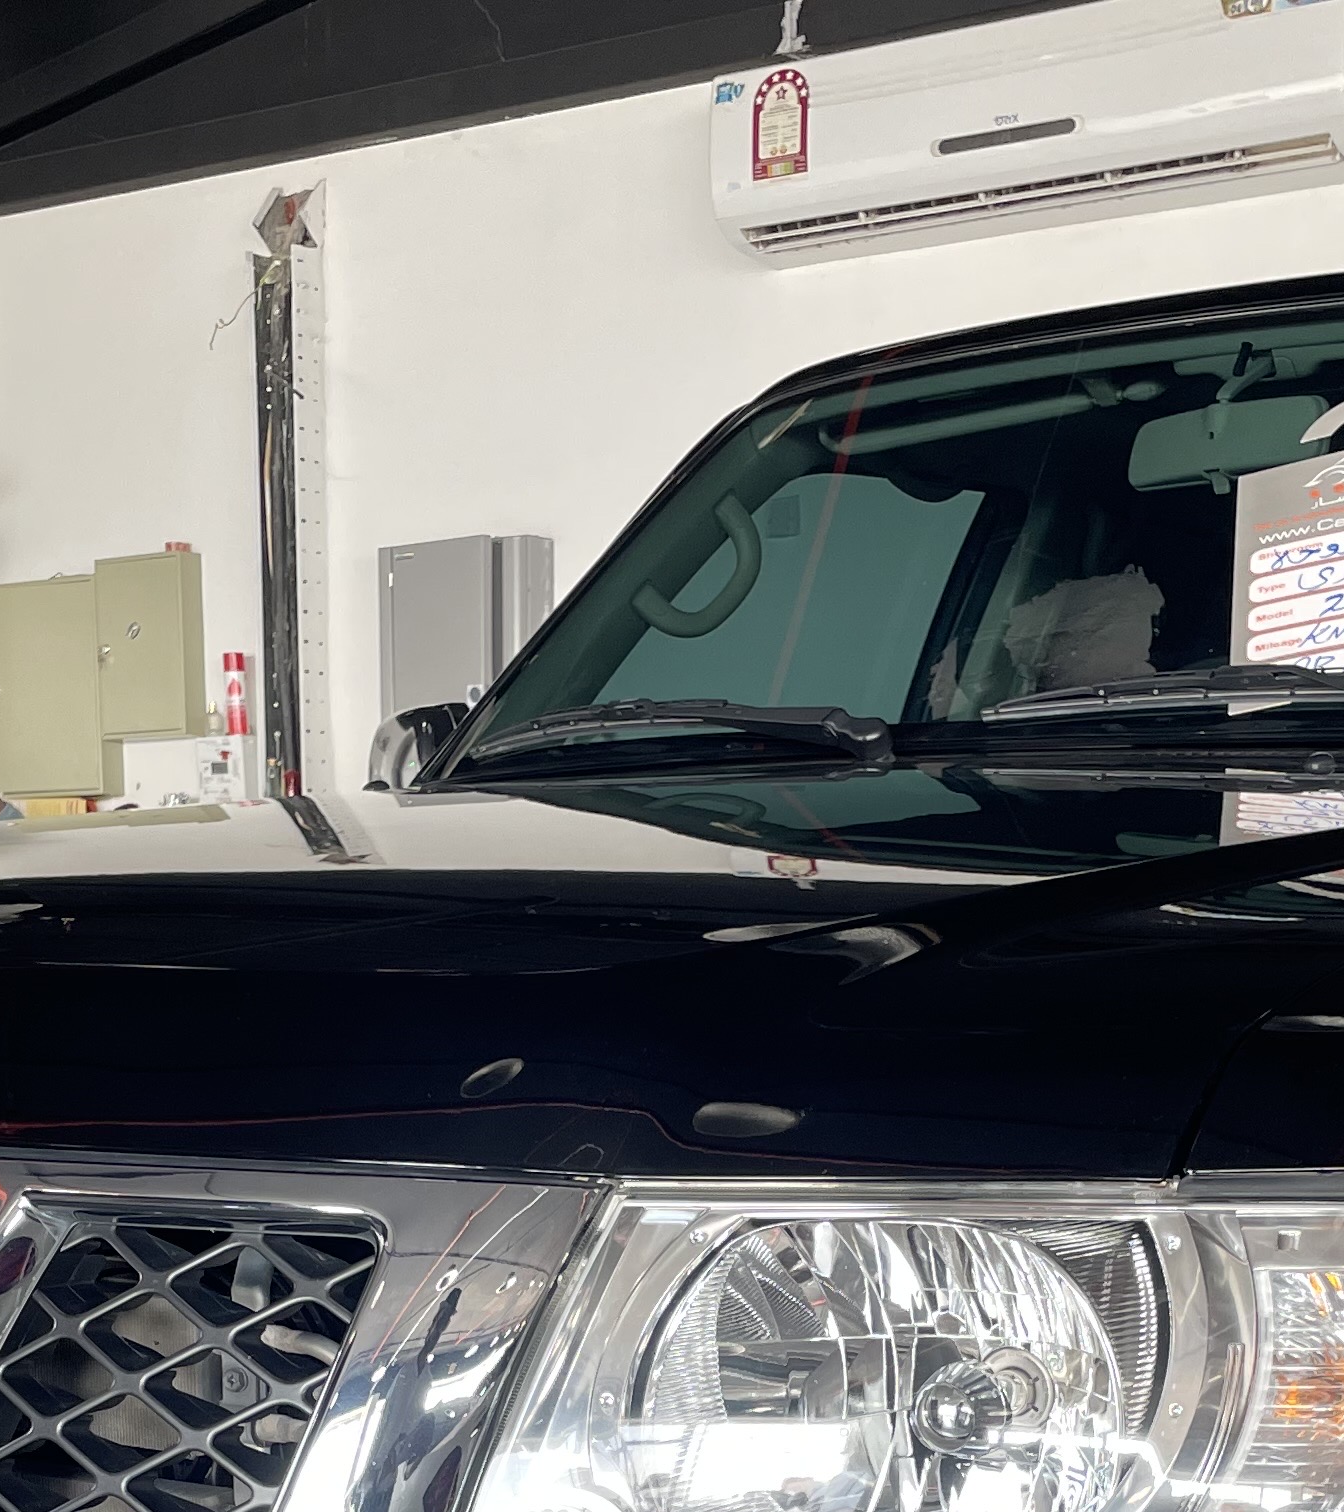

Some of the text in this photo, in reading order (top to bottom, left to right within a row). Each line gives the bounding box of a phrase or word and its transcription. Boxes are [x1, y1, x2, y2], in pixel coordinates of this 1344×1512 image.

[1258, 583, 1287, 594] Type
[1255, 609, 1294, 623] Model
[1254, 637, 1303, 653] Mileage
